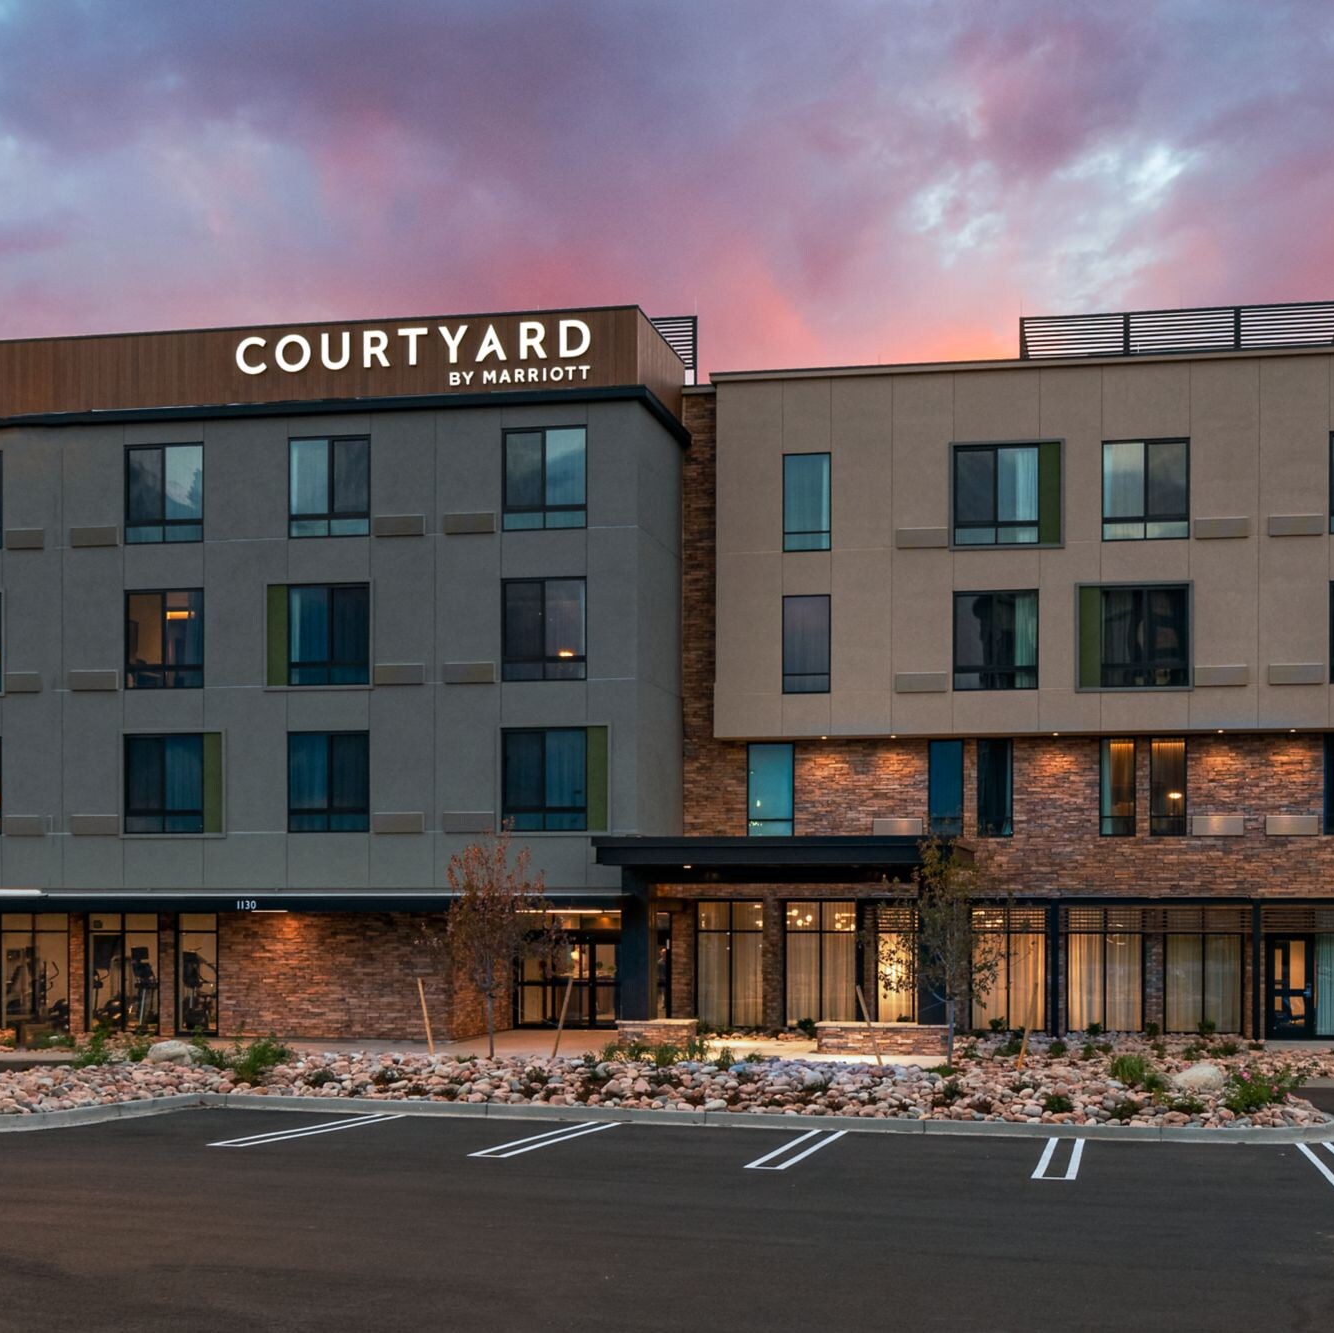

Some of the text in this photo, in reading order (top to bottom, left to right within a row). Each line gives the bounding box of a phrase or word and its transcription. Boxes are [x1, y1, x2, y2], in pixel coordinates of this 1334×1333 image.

[235, 319, 591, 375] COURTYARD
[449, 365, 591, 386] BY MARRIOTT
[237, 900, 257, 910] 1130
